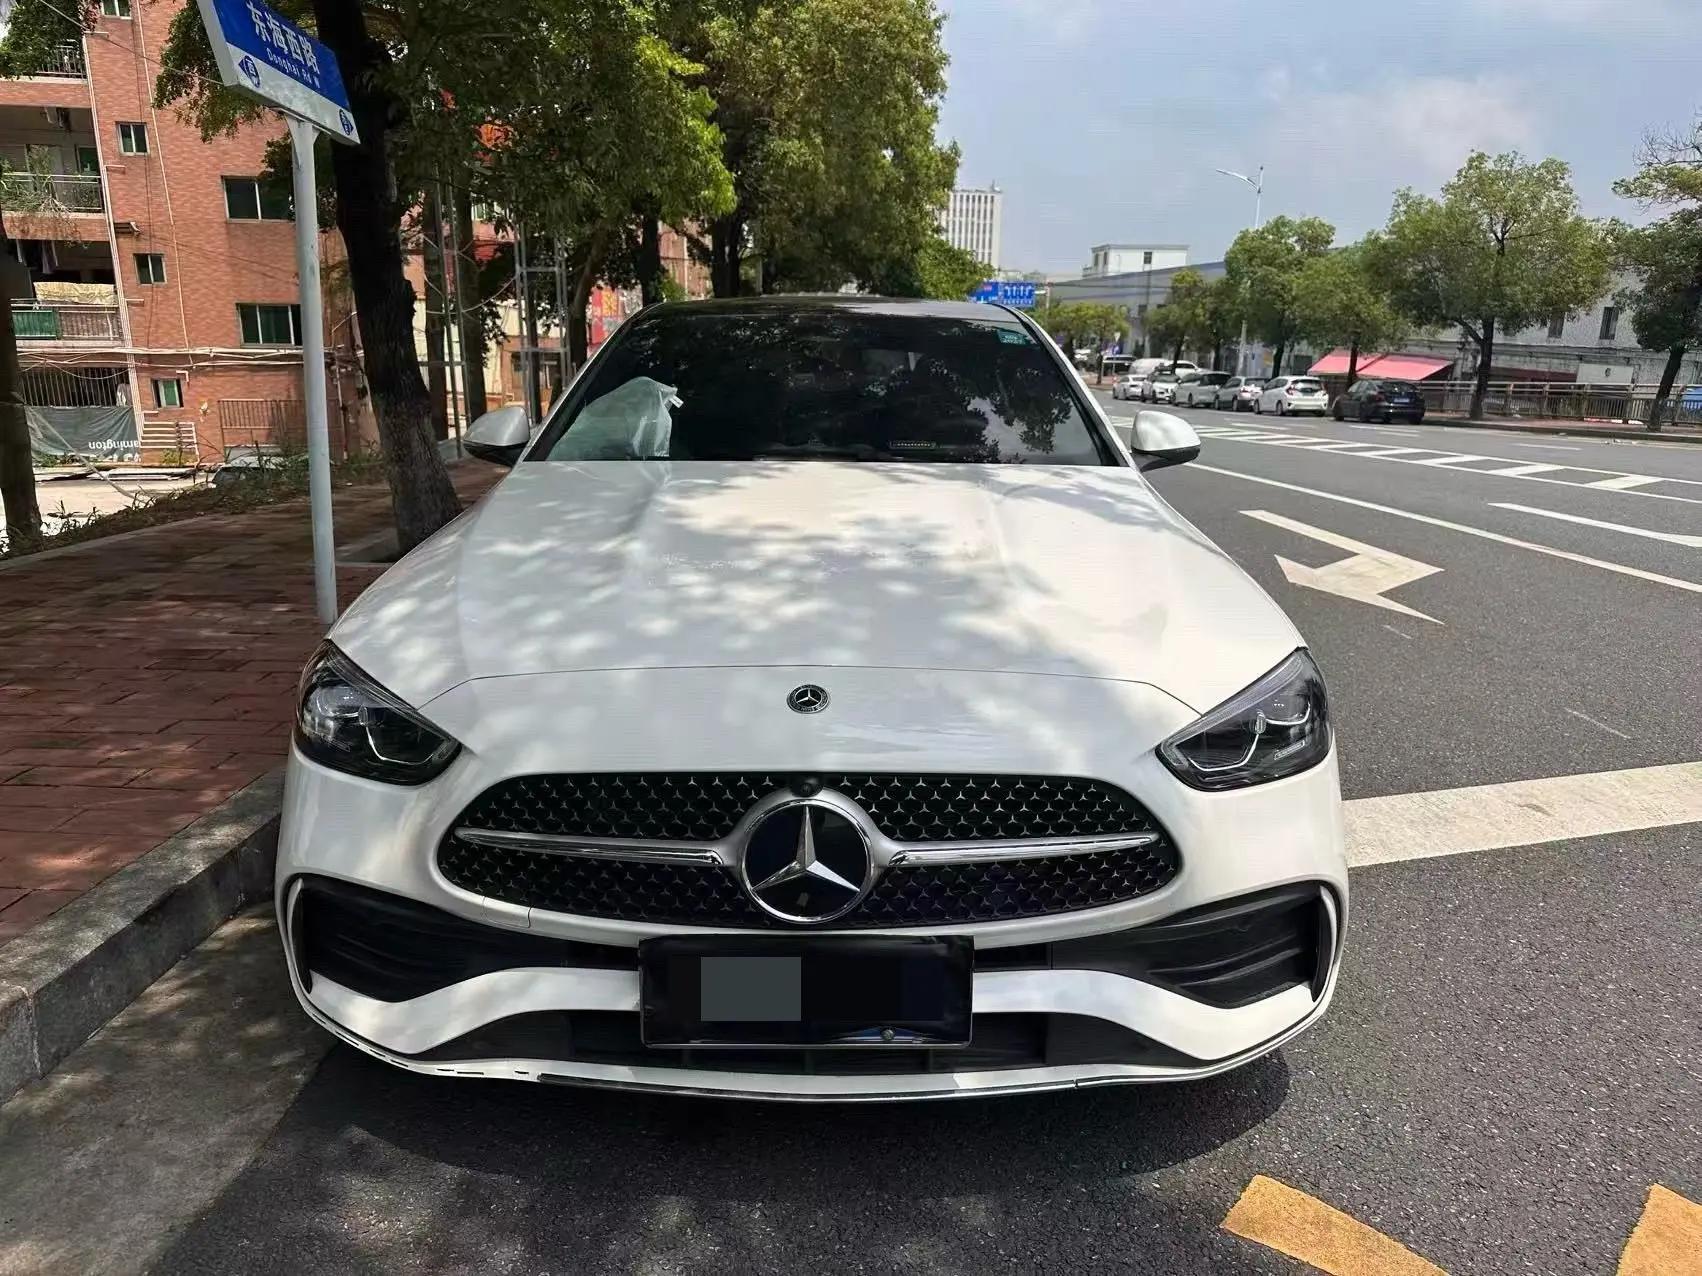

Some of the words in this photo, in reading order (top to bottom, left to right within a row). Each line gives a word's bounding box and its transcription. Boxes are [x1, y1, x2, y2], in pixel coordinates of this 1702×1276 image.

[246, 0, 320, 75] 东海西路
[266, 47, 300, 77] Donghai
